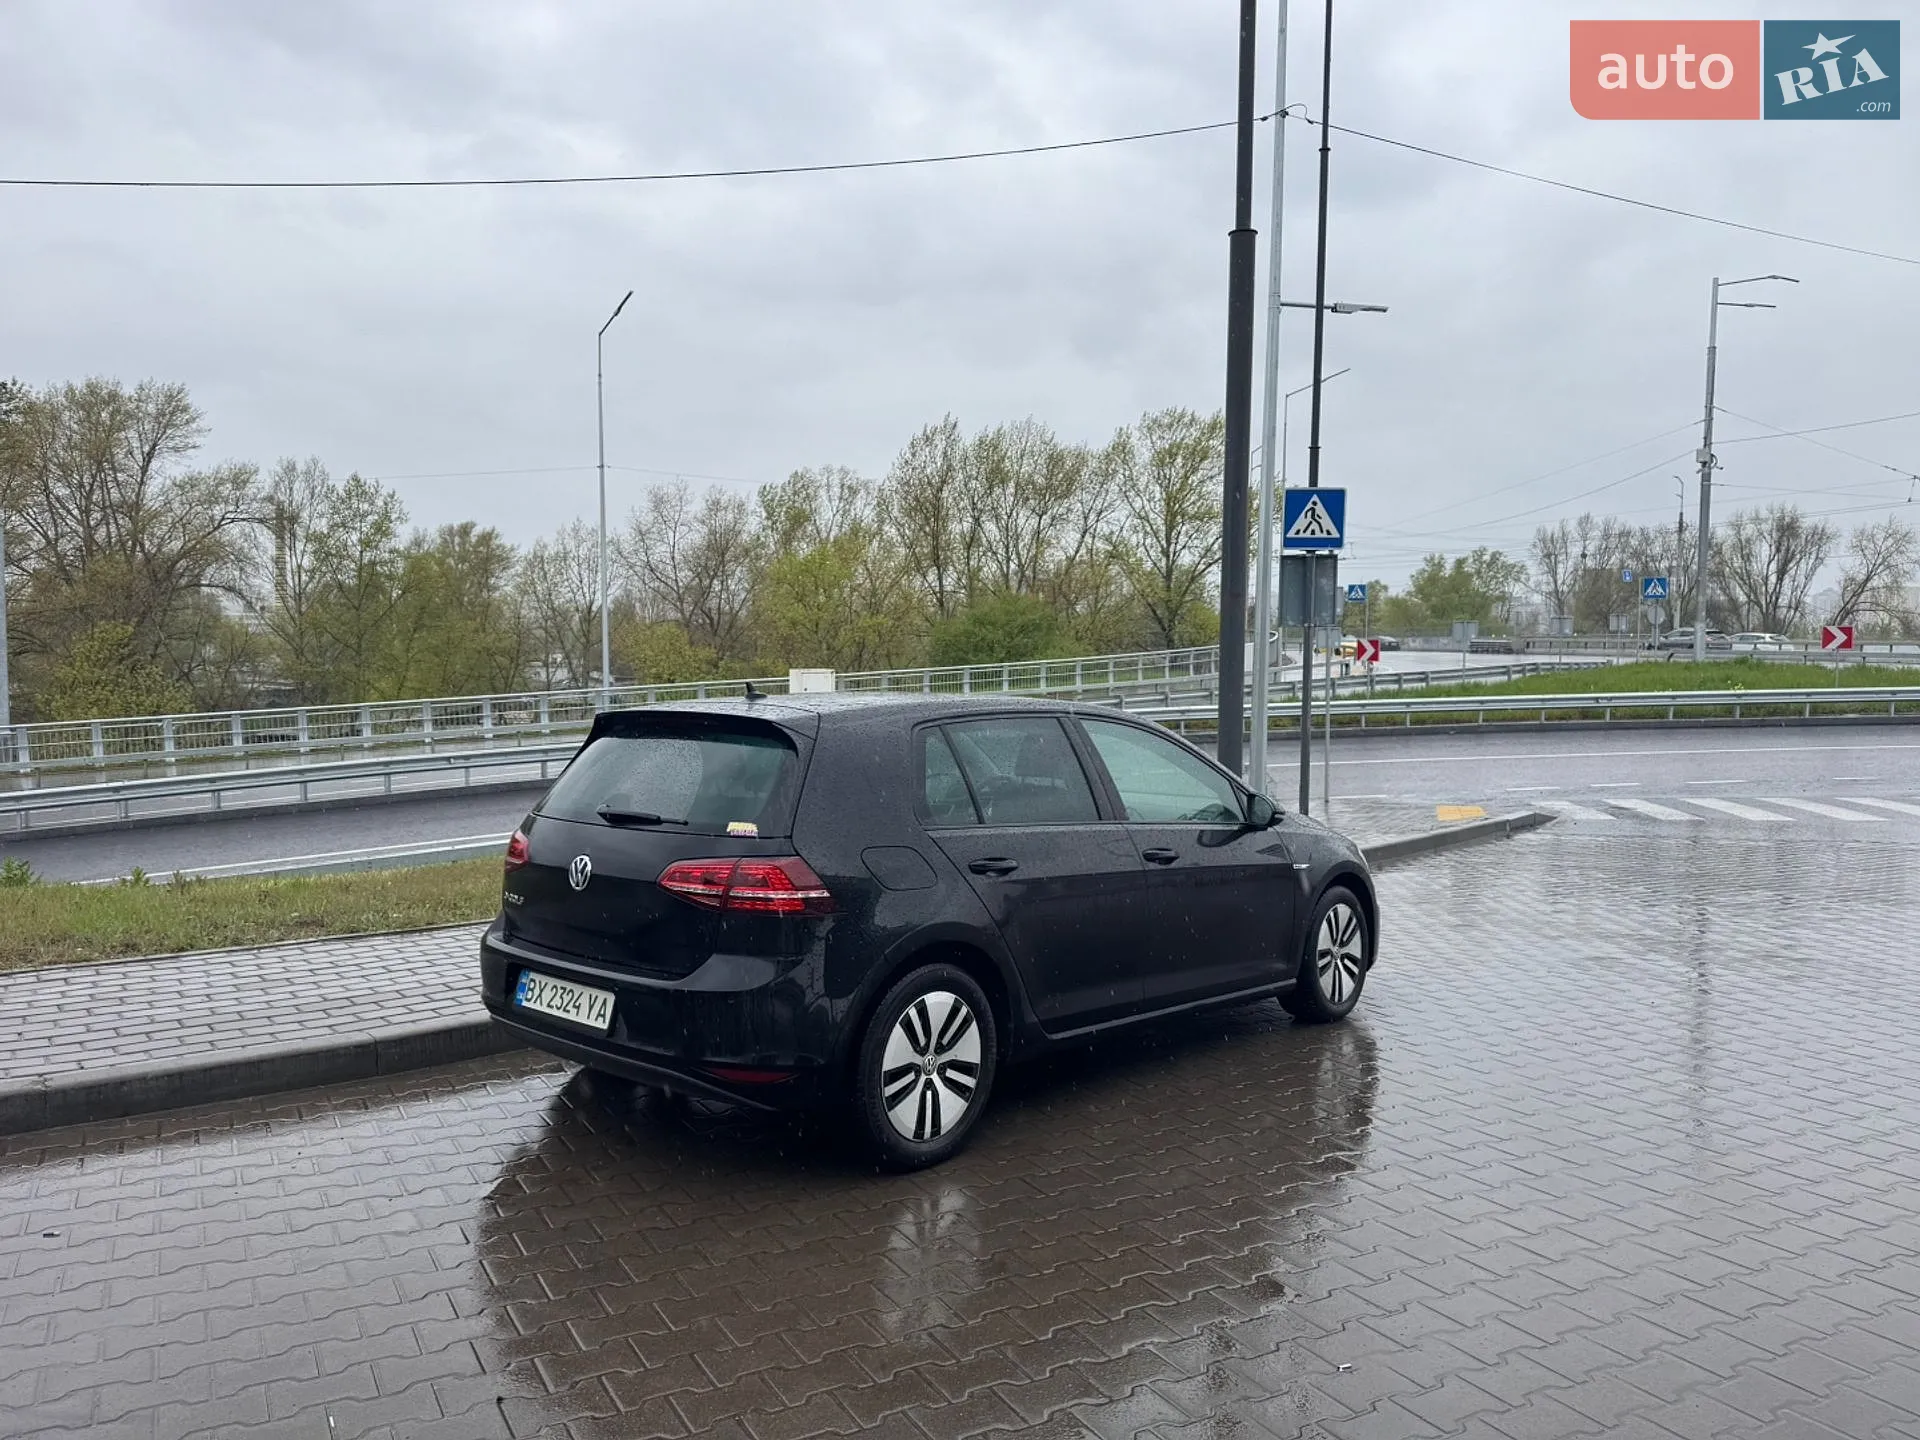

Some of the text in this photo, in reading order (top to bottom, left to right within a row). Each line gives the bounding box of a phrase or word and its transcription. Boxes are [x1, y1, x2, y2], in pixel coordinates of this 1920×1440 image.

[525, 978, 607, 1024] BX 2324 YA
